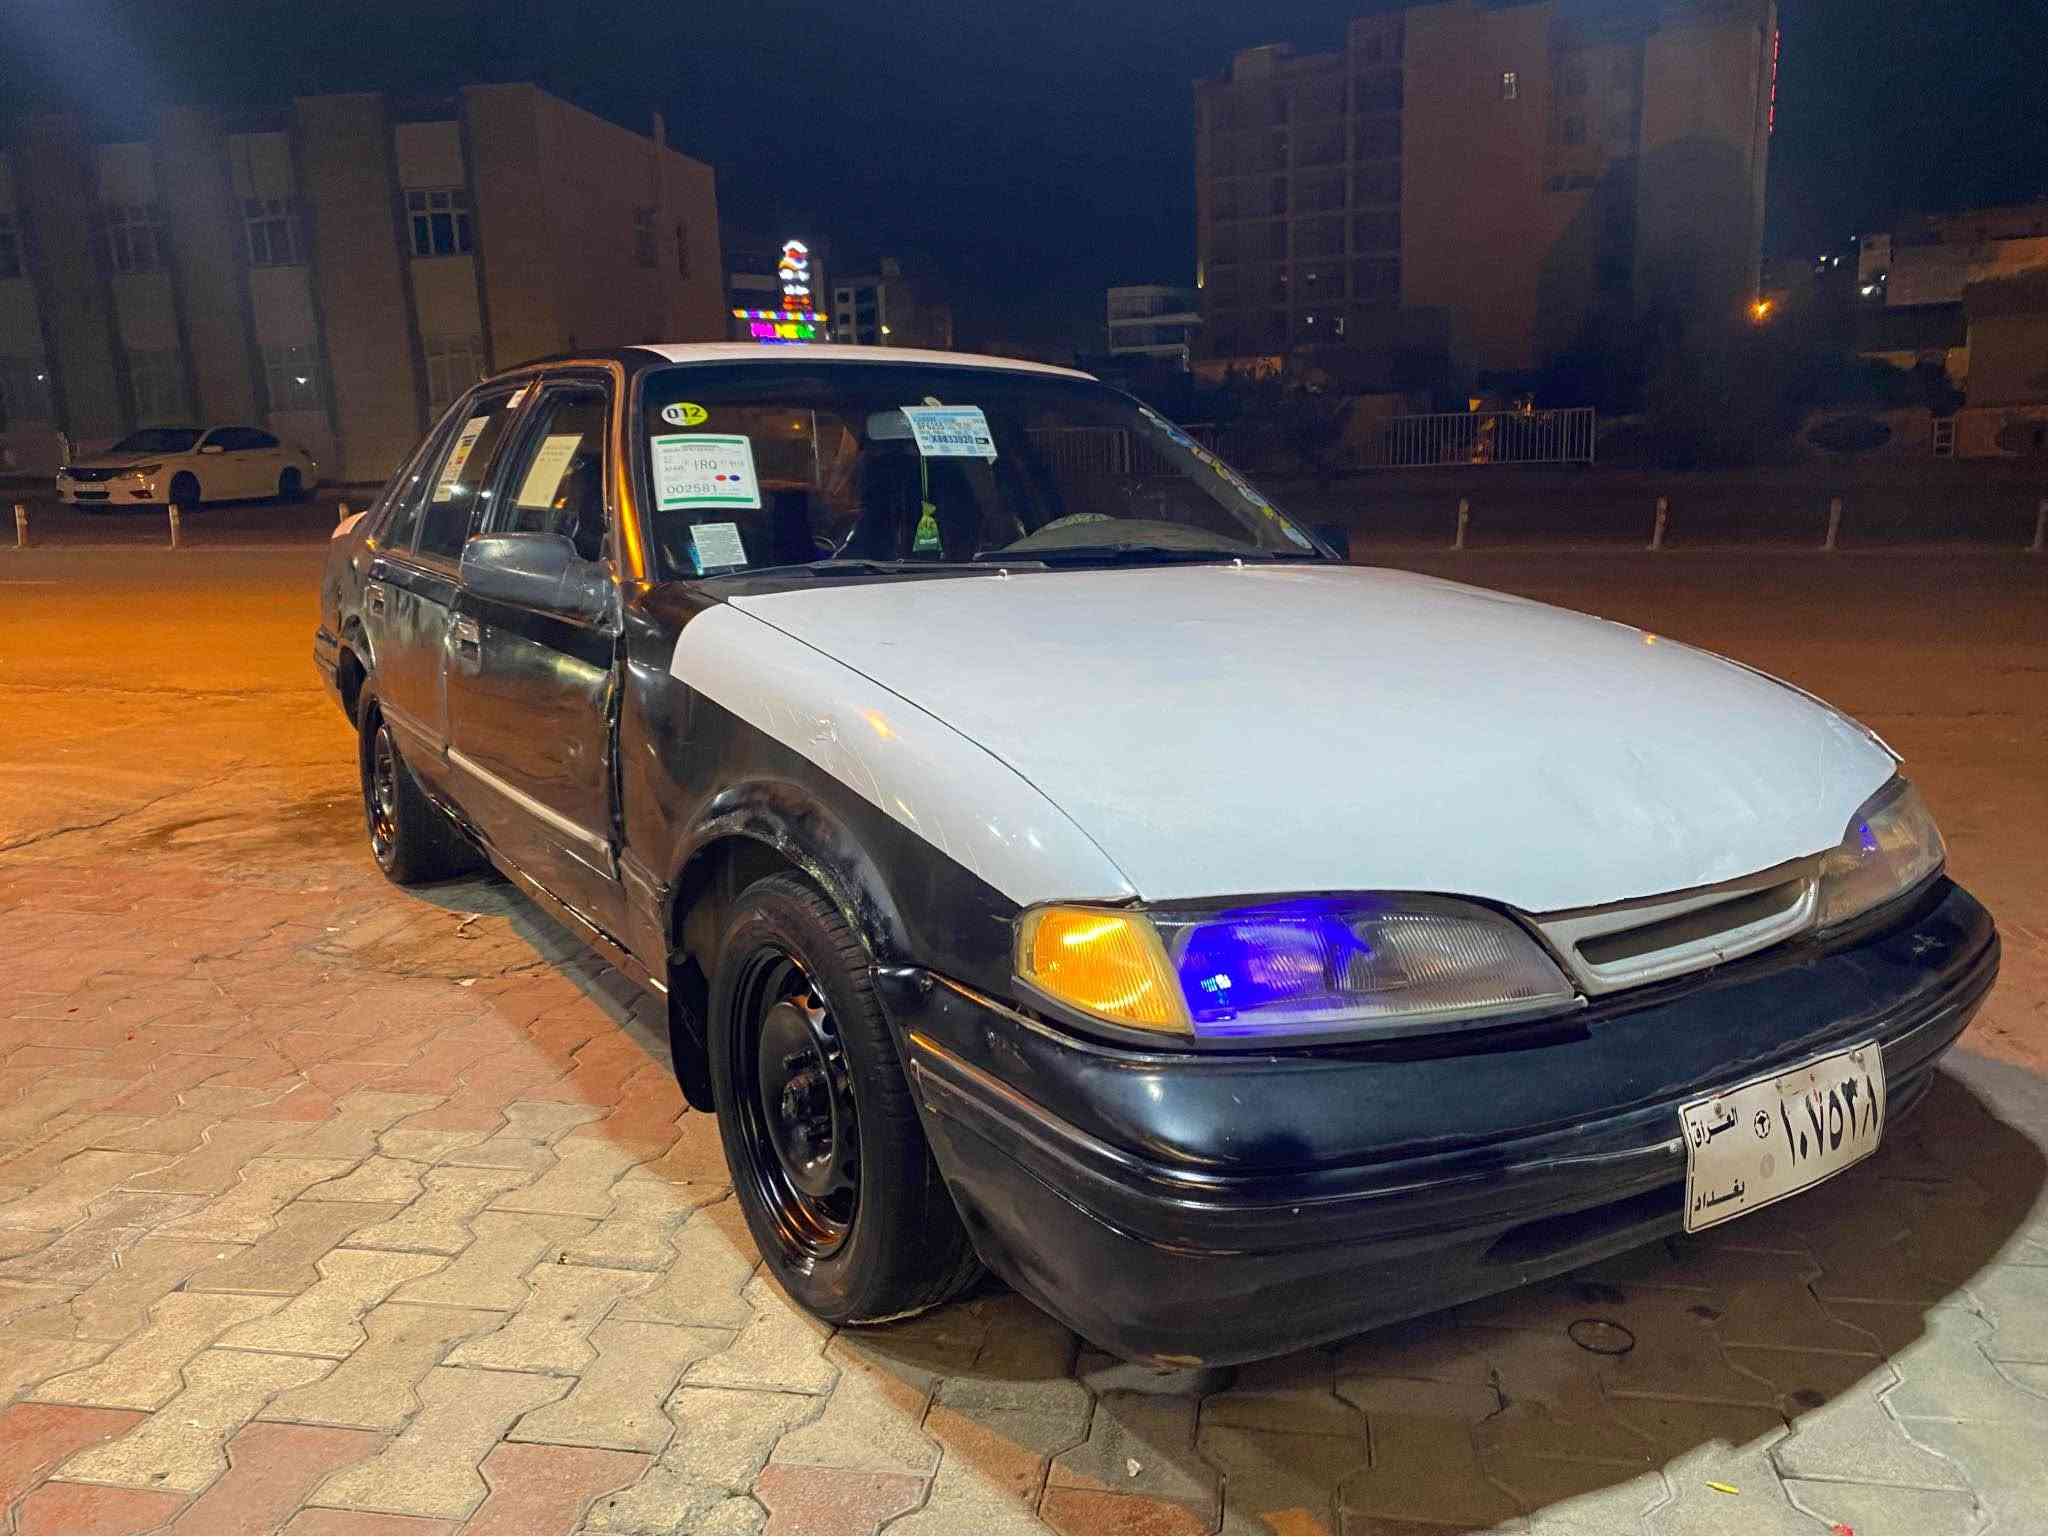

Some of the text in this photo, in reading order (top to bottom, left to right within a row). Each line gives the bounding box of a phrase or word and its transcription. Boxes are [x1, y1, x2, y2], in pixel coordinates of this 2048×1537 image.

[666, 407, 703, 419] 012
[1690, 1105, 1739, 1148] العراق
[1694, 1178, 1745, 1212] بغداد
